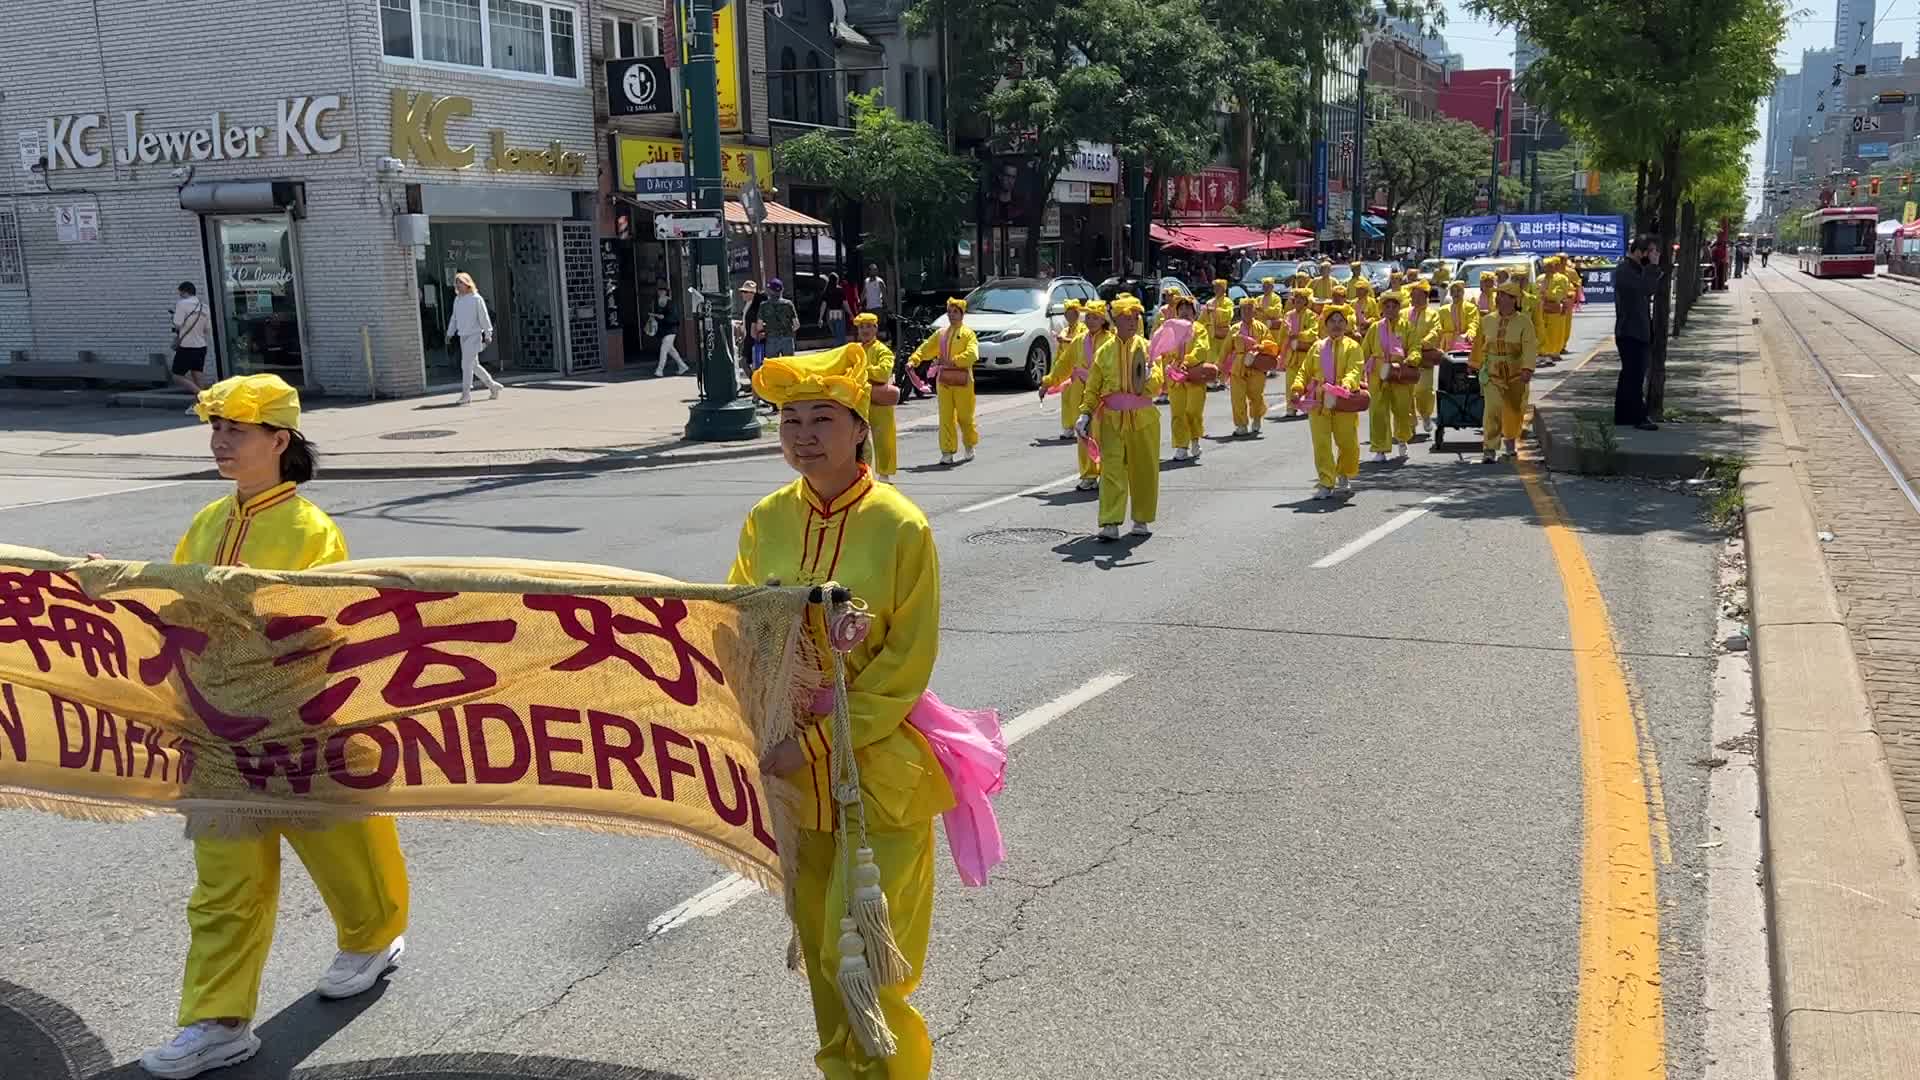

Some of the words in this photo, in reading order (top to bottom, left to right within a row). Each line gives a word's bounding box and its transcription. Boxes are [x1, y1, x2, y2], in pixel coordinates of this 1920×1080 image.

[47, 114, 103, 170] KC
[116, 110, 265, 165] Jeweler
[277, 95, 343, 157] KC
[391, 87, 475, 170] KC
[486, 127, 588, 175] Jeweler
[1447, 241, 1486, 253] Celebrate
[1532, 238, 1565, 249] Chinese
[1566, 238, 1599, 250] Quitting
[231, 700, 781, 857] WONDERFUL
